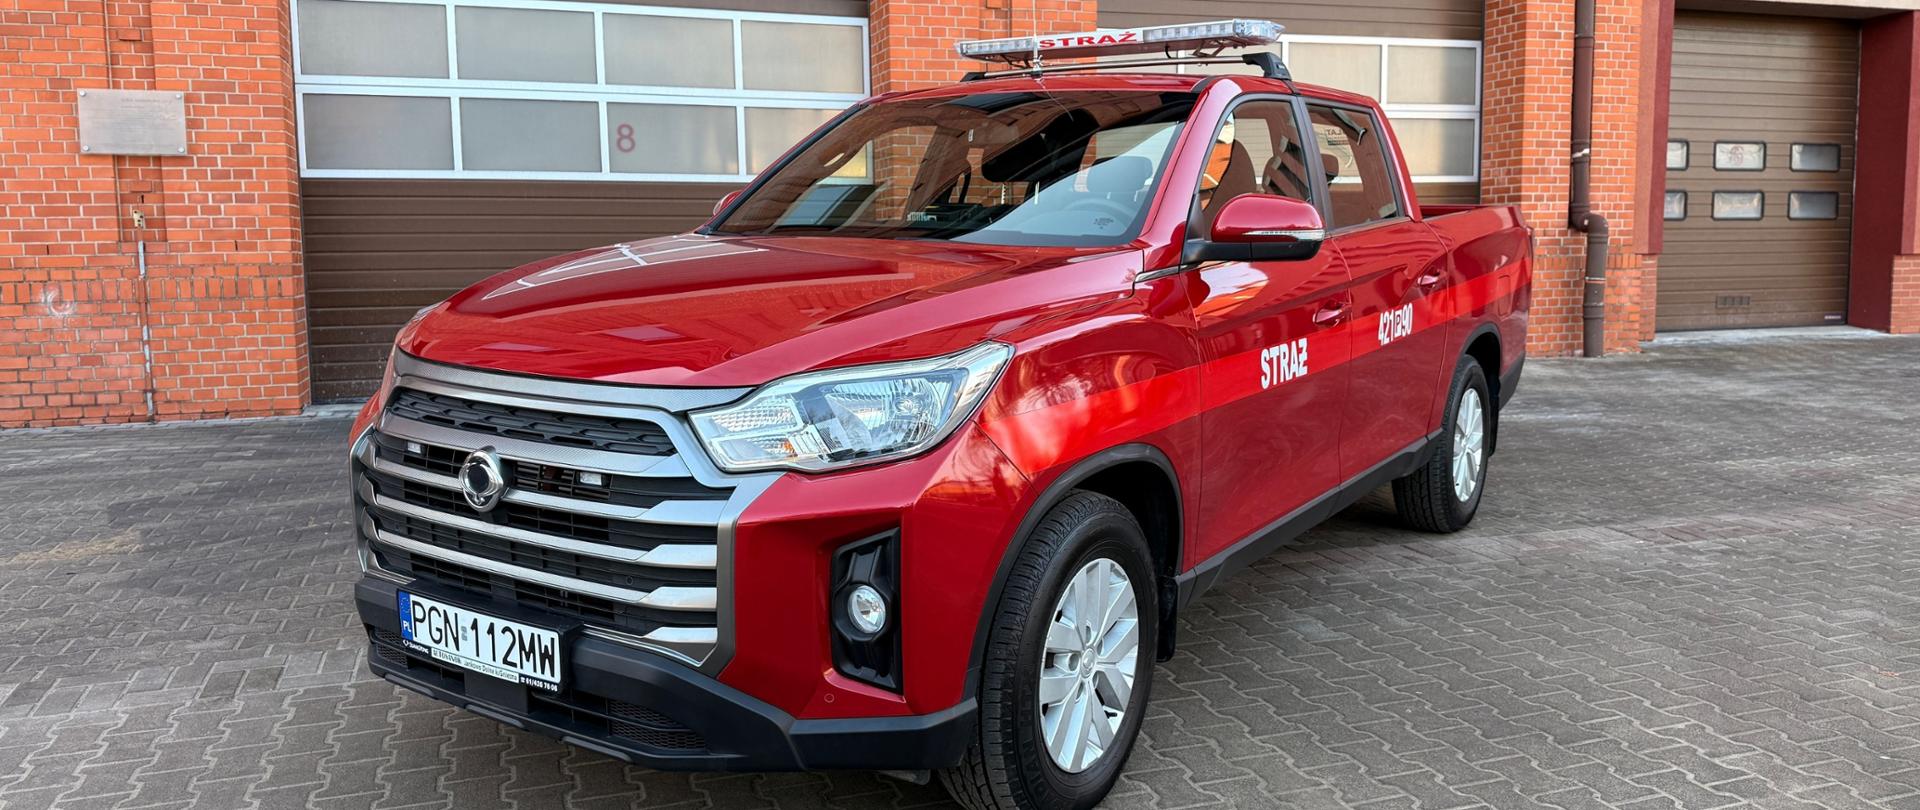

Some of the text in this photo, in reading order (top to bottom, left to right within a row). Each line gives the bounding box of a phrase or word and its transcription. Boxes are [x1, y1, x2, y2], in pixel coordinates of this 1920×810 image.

[1039, 31, 1137, 48] STRAŻ
[617, 123, 636, 153] 8
[1261, 338, 1307, 389] STRAŻ
[403, 621, 412, 633] PL
[412, 600, 556, 678] PGN 112MW
